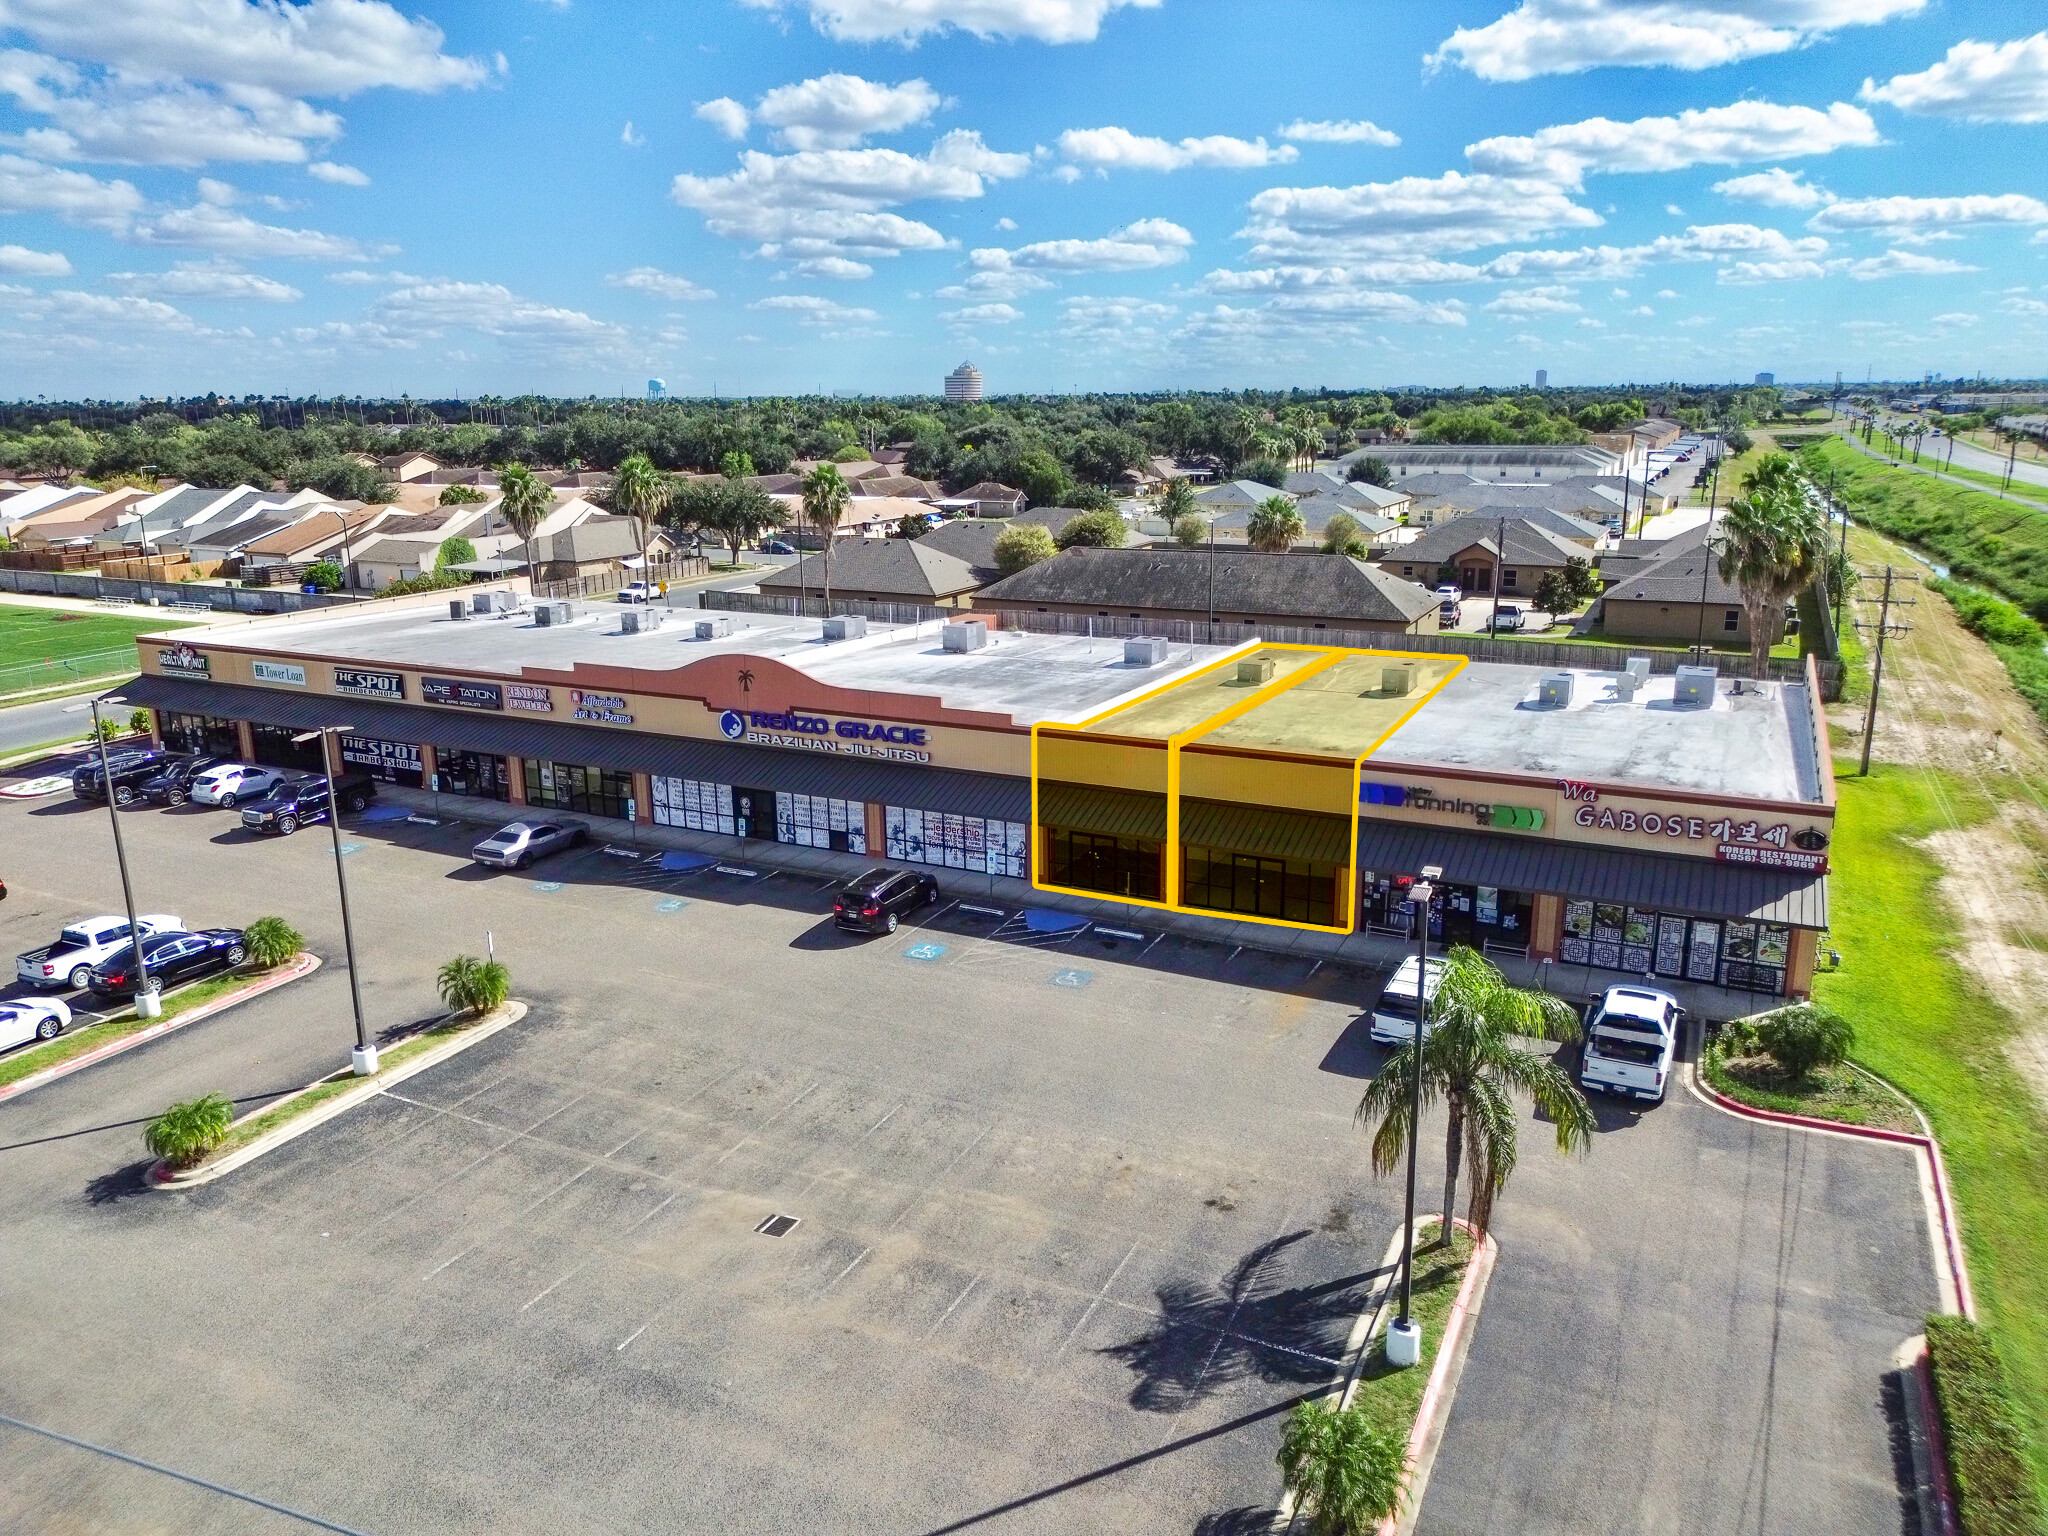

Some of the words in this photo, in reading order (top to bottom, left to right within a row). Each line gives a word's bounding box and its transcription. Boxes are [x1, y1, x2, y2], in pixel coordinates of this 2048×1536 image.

[191, 657, 205, 669] NUT
[265, 665, 284, 679] Tower
[286, 668, 304, 682] Loan
[334, 672, 355, 683] THE
[356, 674, 399, 691] SPOT
[343, 686, 394, 698] BARBERSHOP
[505, 685, 548, 701] RENDON
[507, 698, 552, 712] JEWELERS
[582, 695, 625, 709] Affordable
[572, 708, 588, 720] Art
[601, 709, 632, 725] Frame
[750, 711, 829, 735] RENZO
[835, 721, 926, 746] GRACIE
[342, 738, 366, 750] THE
[368, 742, 420, 760] SPOT
[746, 732, 837, 752] BRAZILIAN
[844, 743, 930, 763] JIU-JITSU
[1559, 780, 1598, 802] Wa
[1406, 798, 1489, 818] running
[933, 823, 980, 837] leadership
[1575, 806, 1704, 839] GABOSE
[1709, 819, 1789, 849] 가보세
[1719, 845, 1758, 857] KOREAN
[1759, 849, 1825, 864] RESTAURANT
